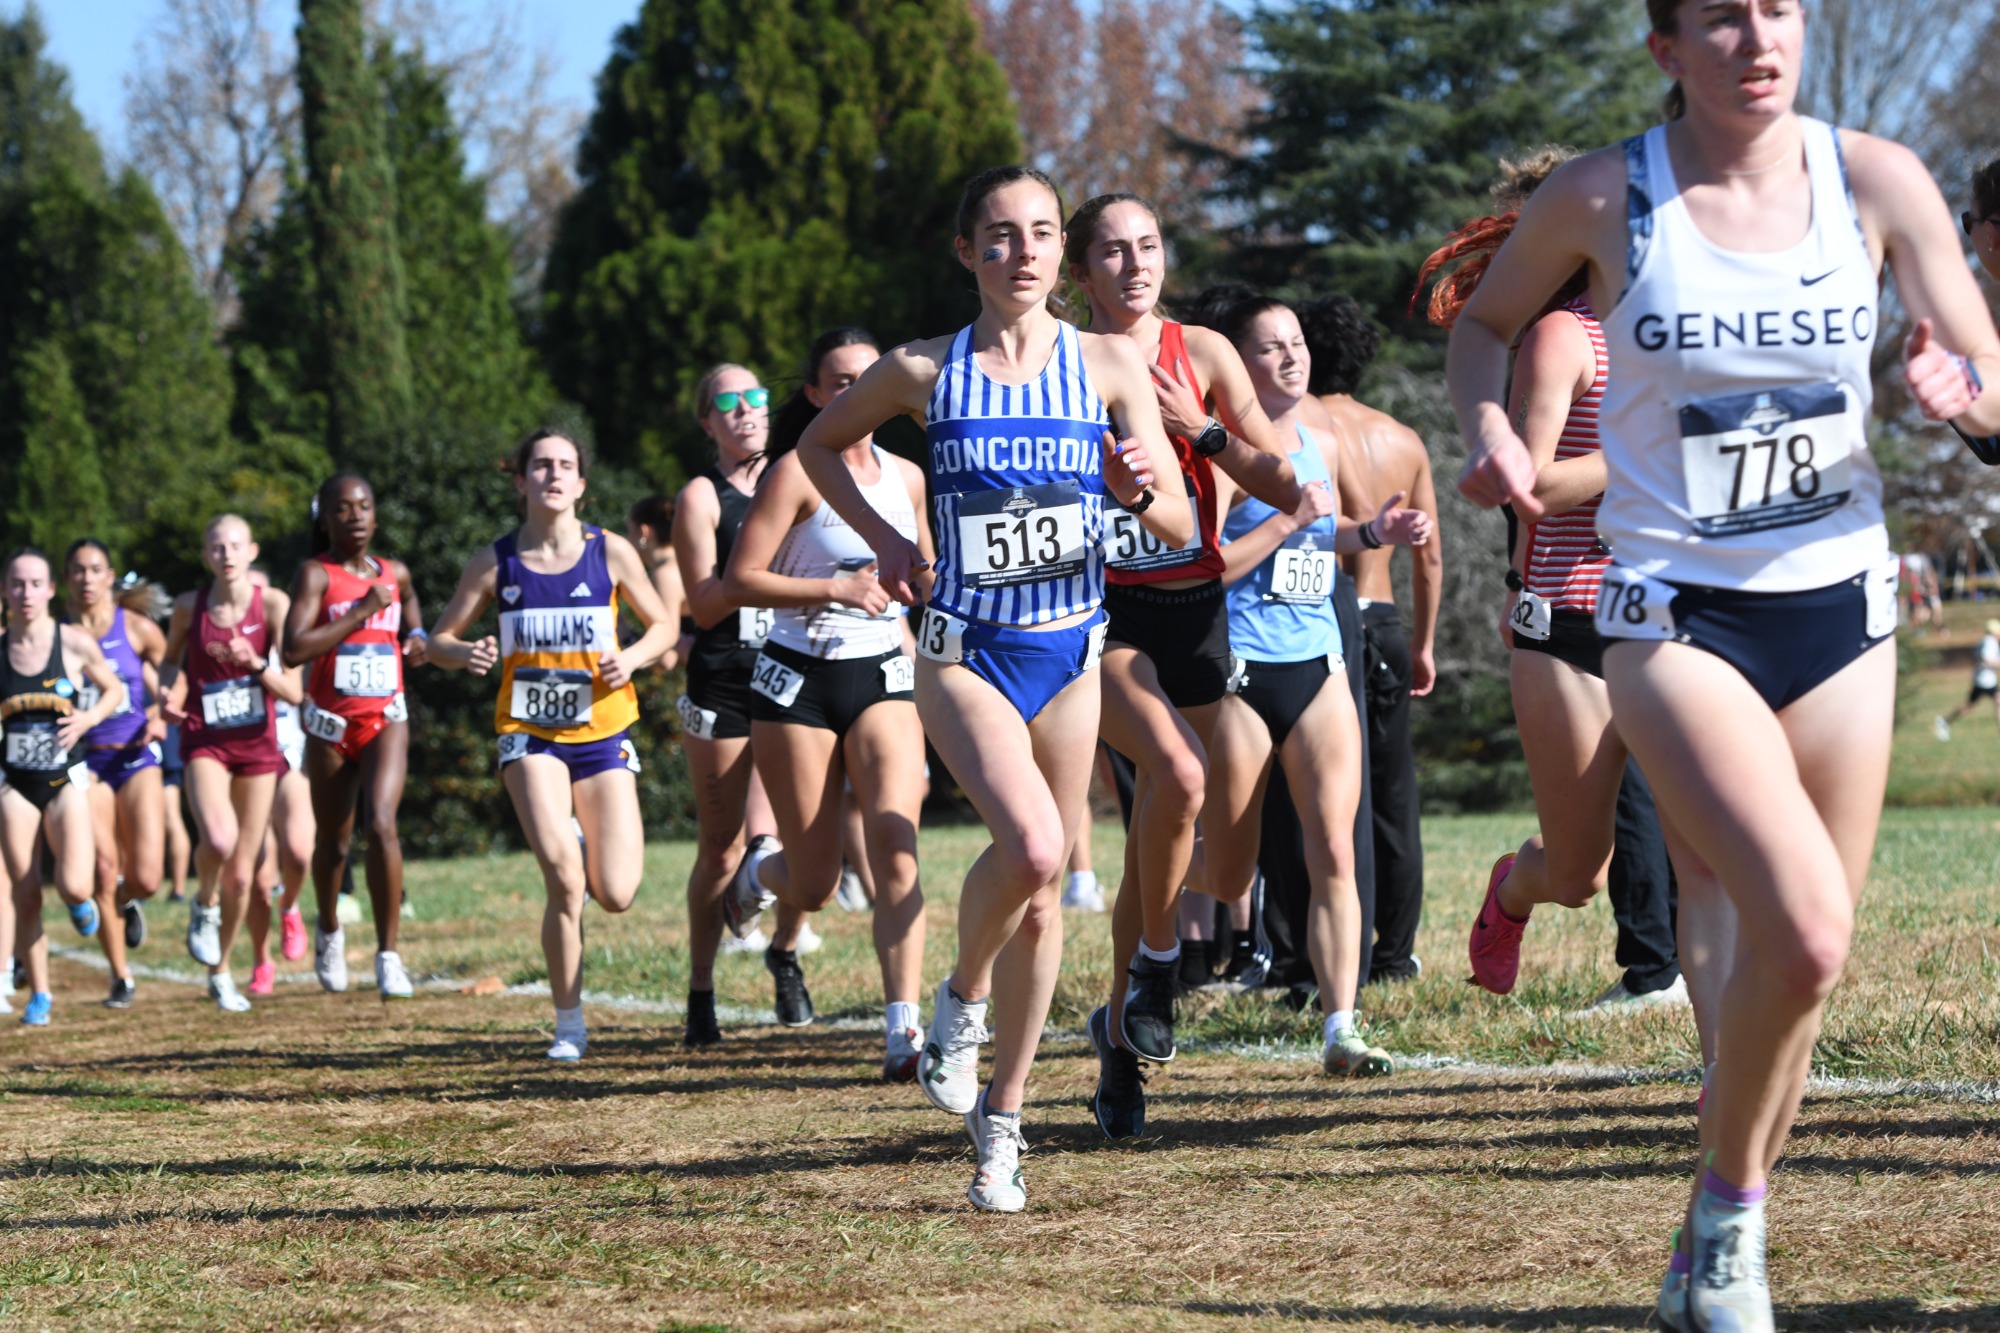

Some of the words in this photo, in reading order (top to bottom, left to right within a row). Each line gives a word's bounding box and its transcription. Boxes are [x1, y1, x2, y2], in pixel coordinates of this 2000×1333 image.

[1634, 305, 1873, 352] GENESEO
[934, 436, 1100, 475] CONCORDIA
[1719, 433, 1821, 511] 778
[986, 516, 1061, 570] 513
[1114, 515, 1184, 559] 50
[1286, 557, 1324, 593] 568
[511, 613, 596, 649] WILLIAMS
[918, 611, 948, 656] 13
[349, 662, 386, 689] 515
[526, 687, 579, 720] 888
